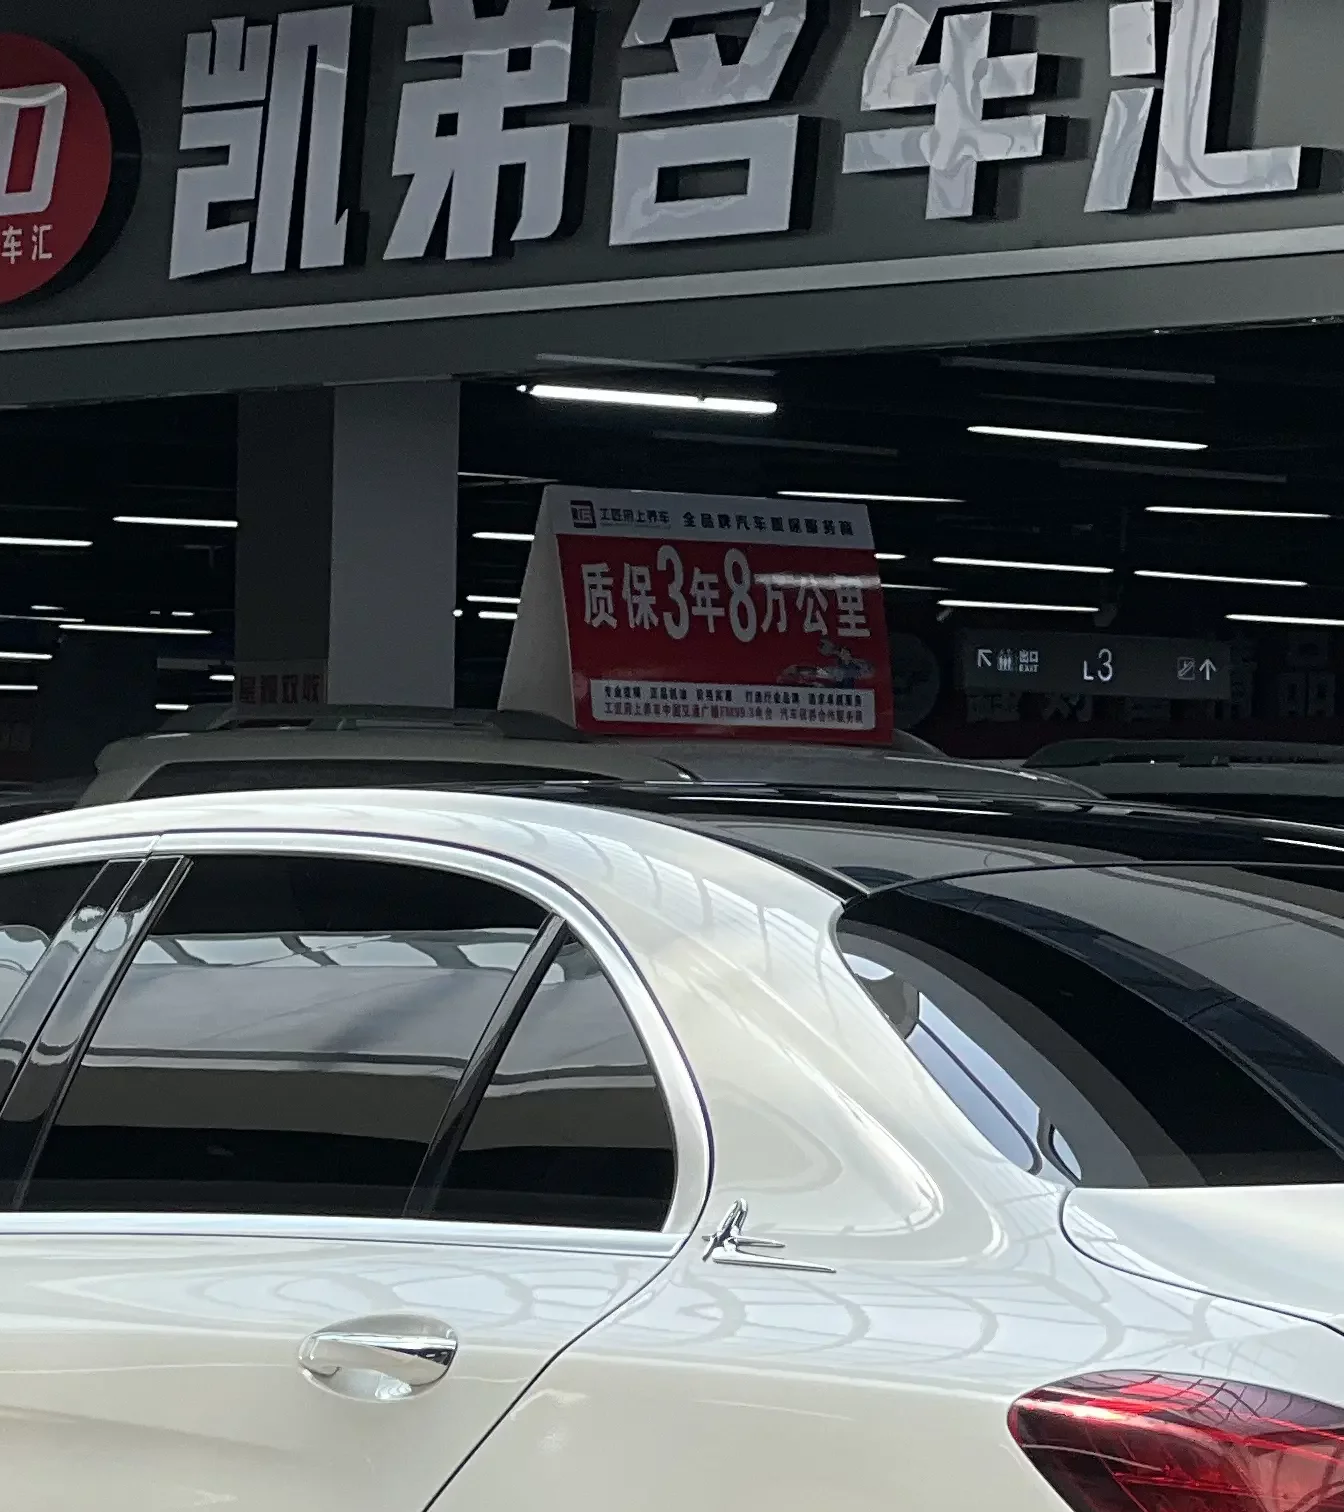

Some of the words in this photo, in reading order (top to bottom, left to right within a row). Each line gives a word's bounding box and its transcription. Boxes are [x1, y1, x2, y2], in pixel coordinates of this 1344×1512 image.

[169, 0, 1304, 279] 凯弟名车汇
[580, 544, 872, 643] 质保3年8万公里
[1083, 648, 1113, 682] L3
